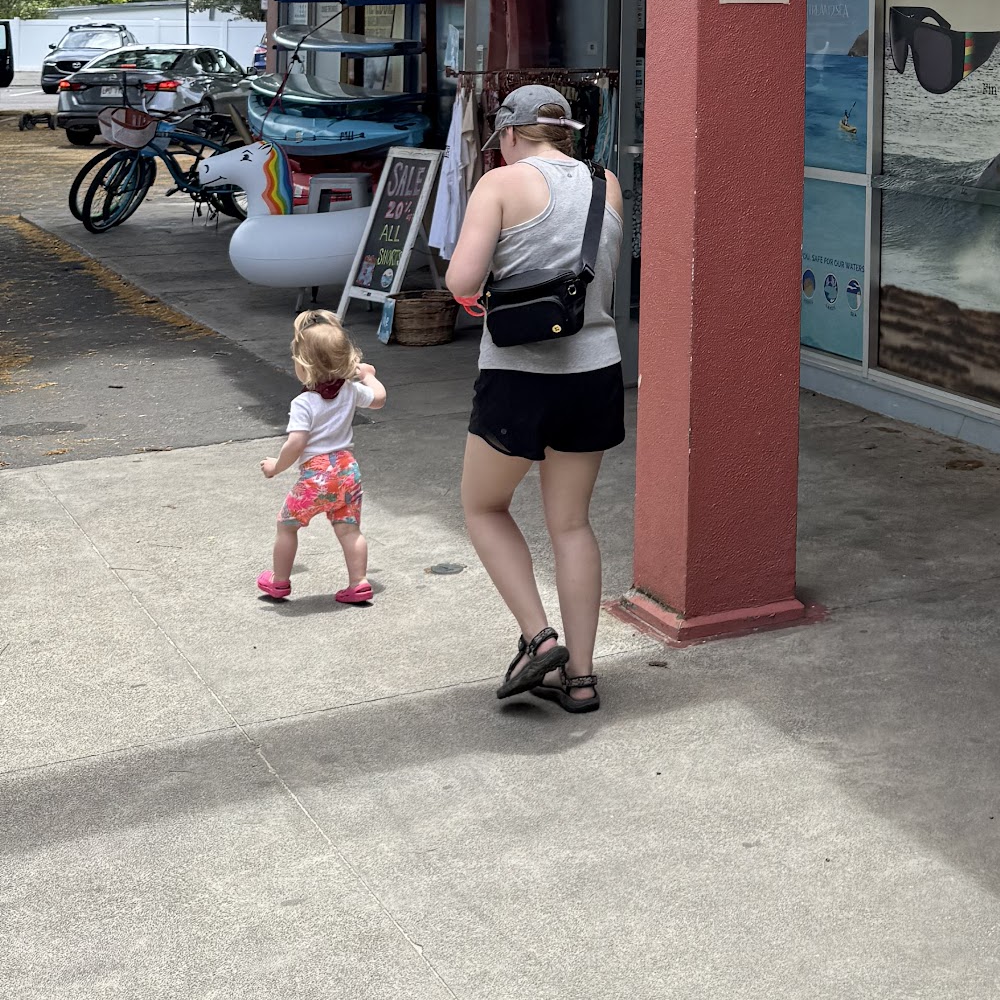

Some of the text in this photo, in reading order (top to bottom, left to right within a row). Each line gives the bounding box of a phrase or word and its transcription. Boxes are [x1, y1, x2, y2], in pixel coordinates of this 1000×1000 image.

[387, 161, 426, 198] SALE
[384, 200, 413, 220] 20%
[379, 224, 400, 242] ALL
[377, 247, 404, 266] SHORTS
[811, 254, 823, 264] SAFE
[823, 257, 834, 266] FOR
[834, 259, 845, 269] OUR
[845, 262, 865, 273] WATERS
